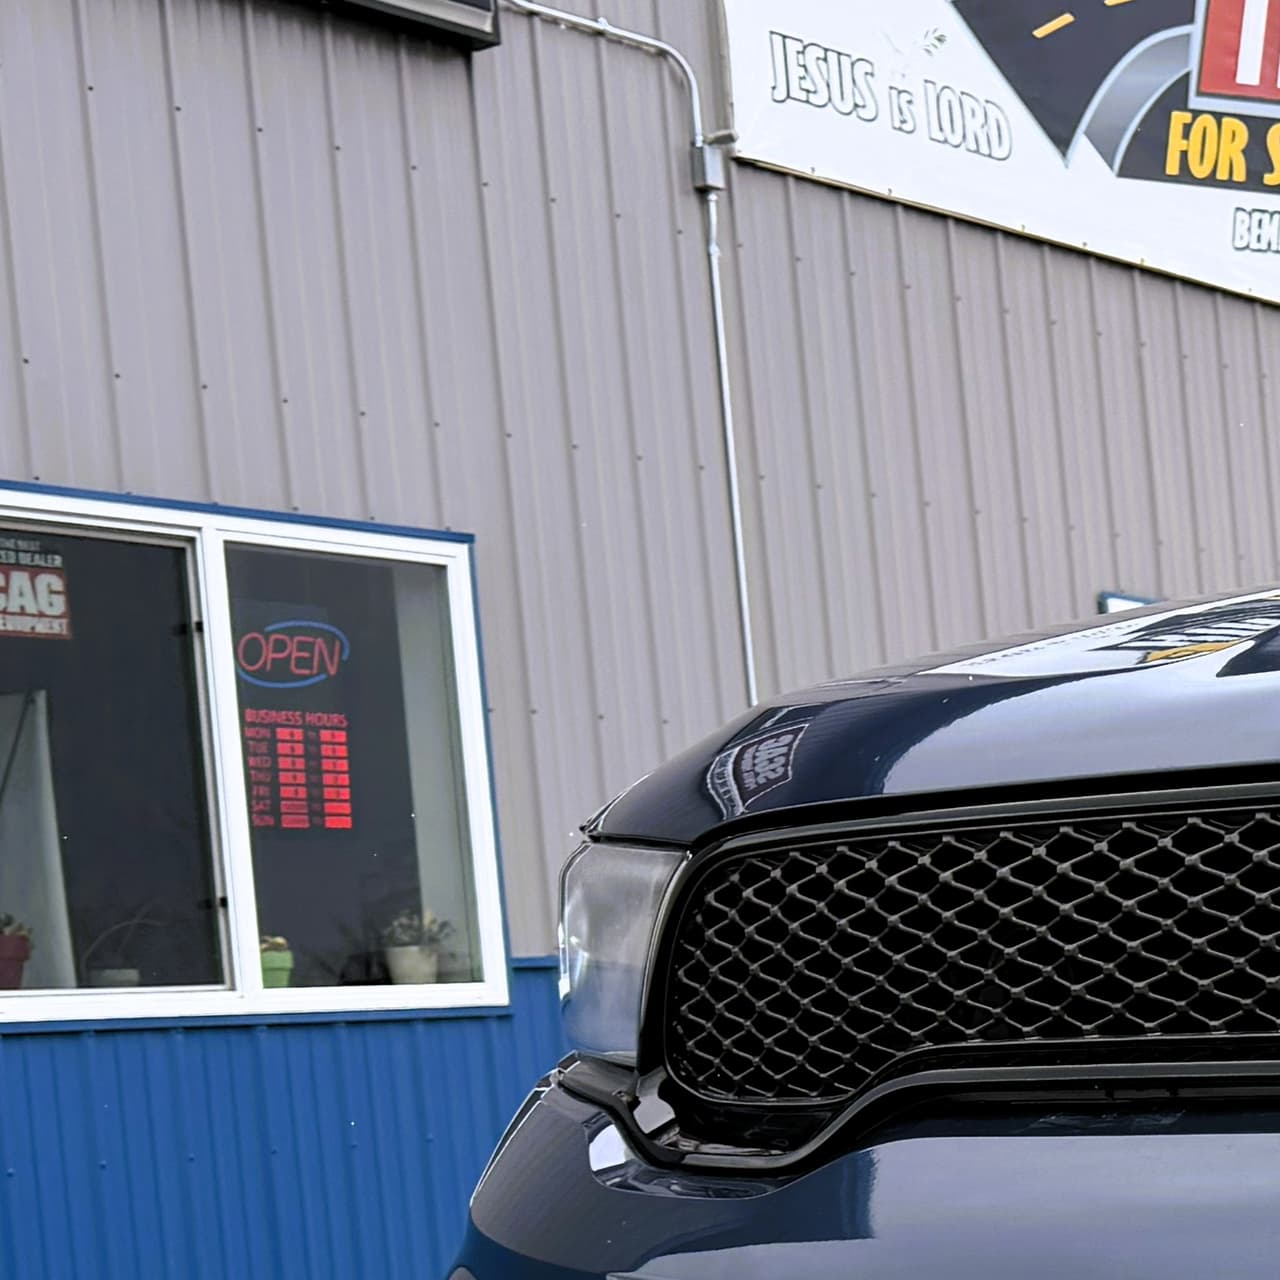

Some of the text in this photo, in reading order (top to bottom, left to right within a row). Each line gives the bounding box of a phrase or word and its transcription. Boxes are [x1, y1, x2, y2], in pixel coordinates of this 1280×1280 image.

[769, 30, 1012, 161] JESUS IS LORD
[1165, 110, 1249, 183] FOR
[0, 570, 65, 616] AG
[237, 631, 341, 677] OPEN
[244, 709, 348, 727] BUSINESS HOURS
